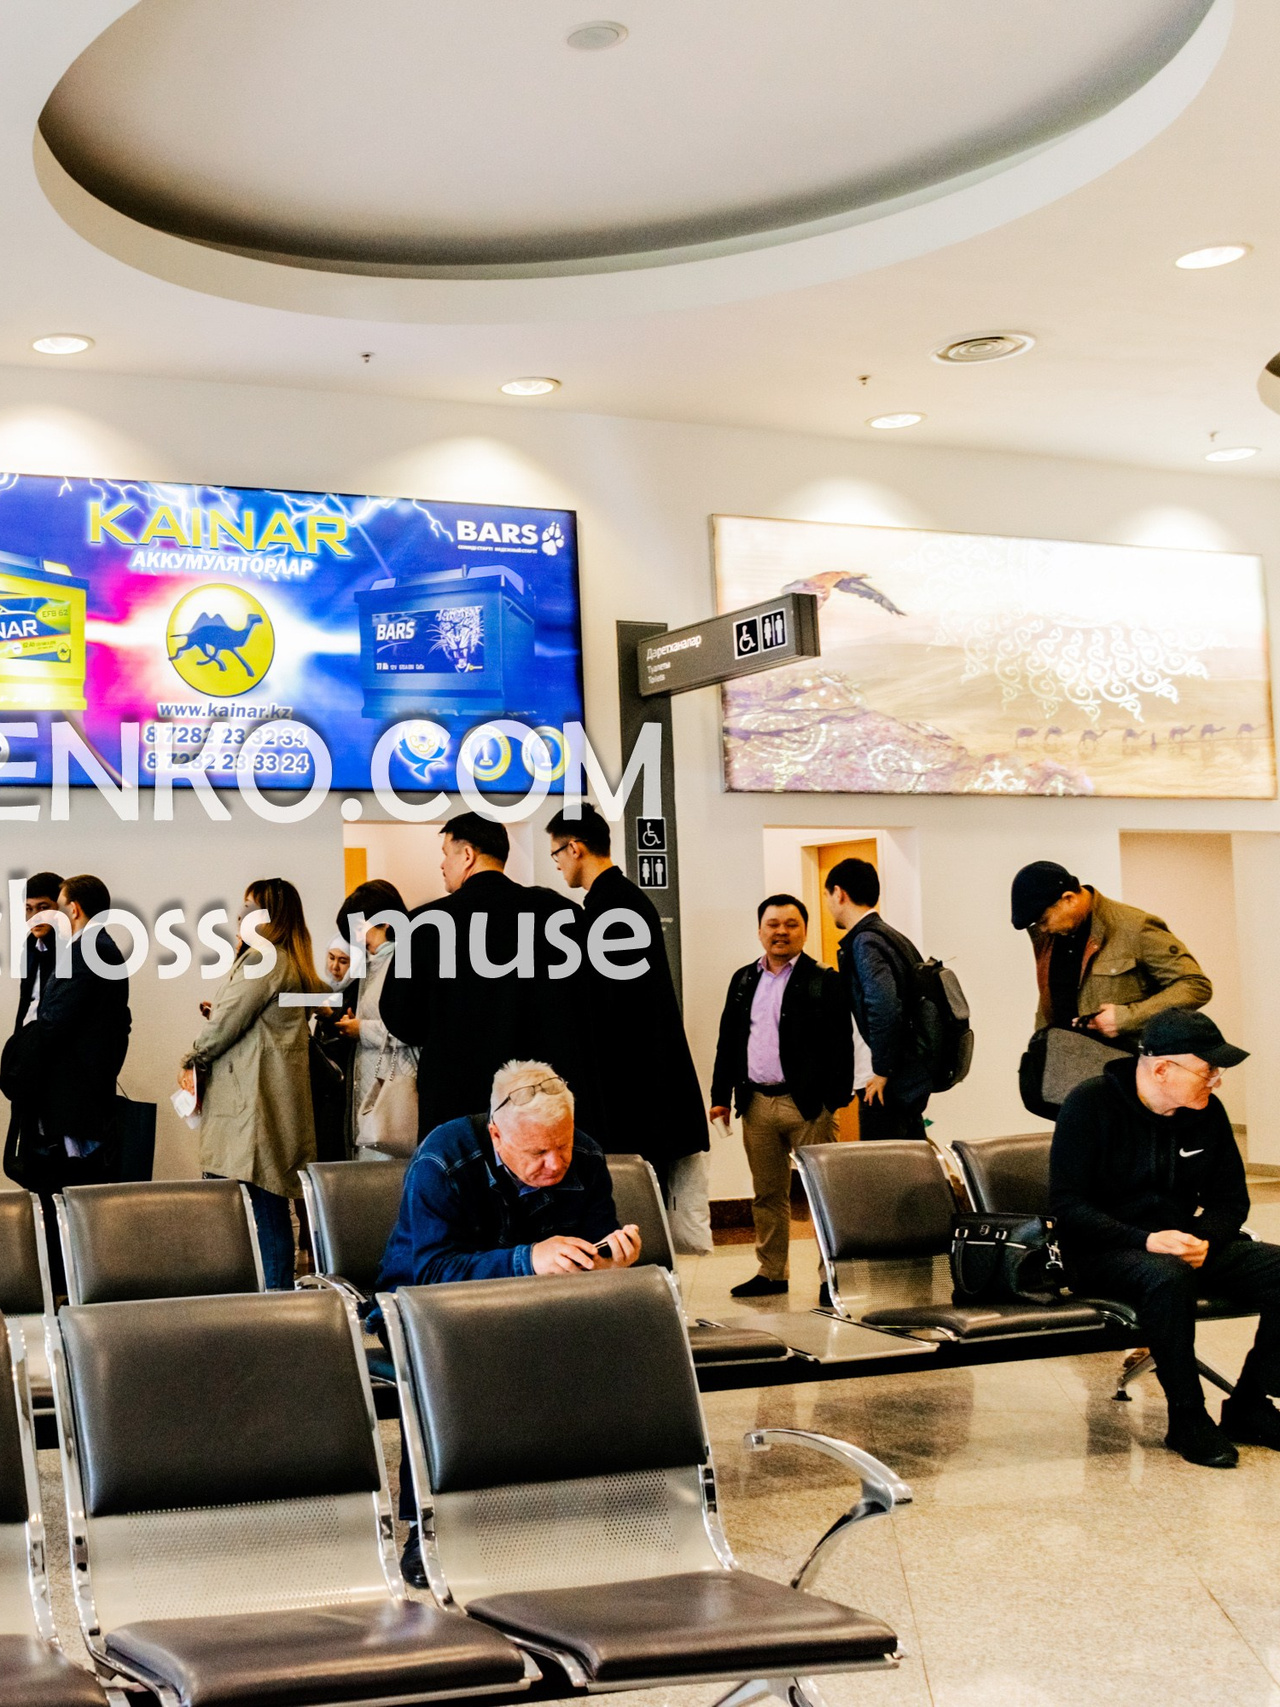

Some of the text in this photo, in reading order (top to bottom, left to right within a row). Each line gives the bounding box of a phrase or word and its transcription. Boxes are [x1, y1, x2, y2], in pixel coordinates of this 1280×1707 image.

[89, 501, 352, 558] KAINAR
[456, 519, 539, 546] BARS
[131, 550, 315, 576] АККУМУЛЯТОРЛАР
[375, 621, 417, 641] BARS
[159, 702, 292, 720] www.kainar.kz
[145, 725, 158, 743] 8
[222, 728, 246, 745] 23
[146, 751, 159, 769] 8
[282, 755, 308, 773] 24
